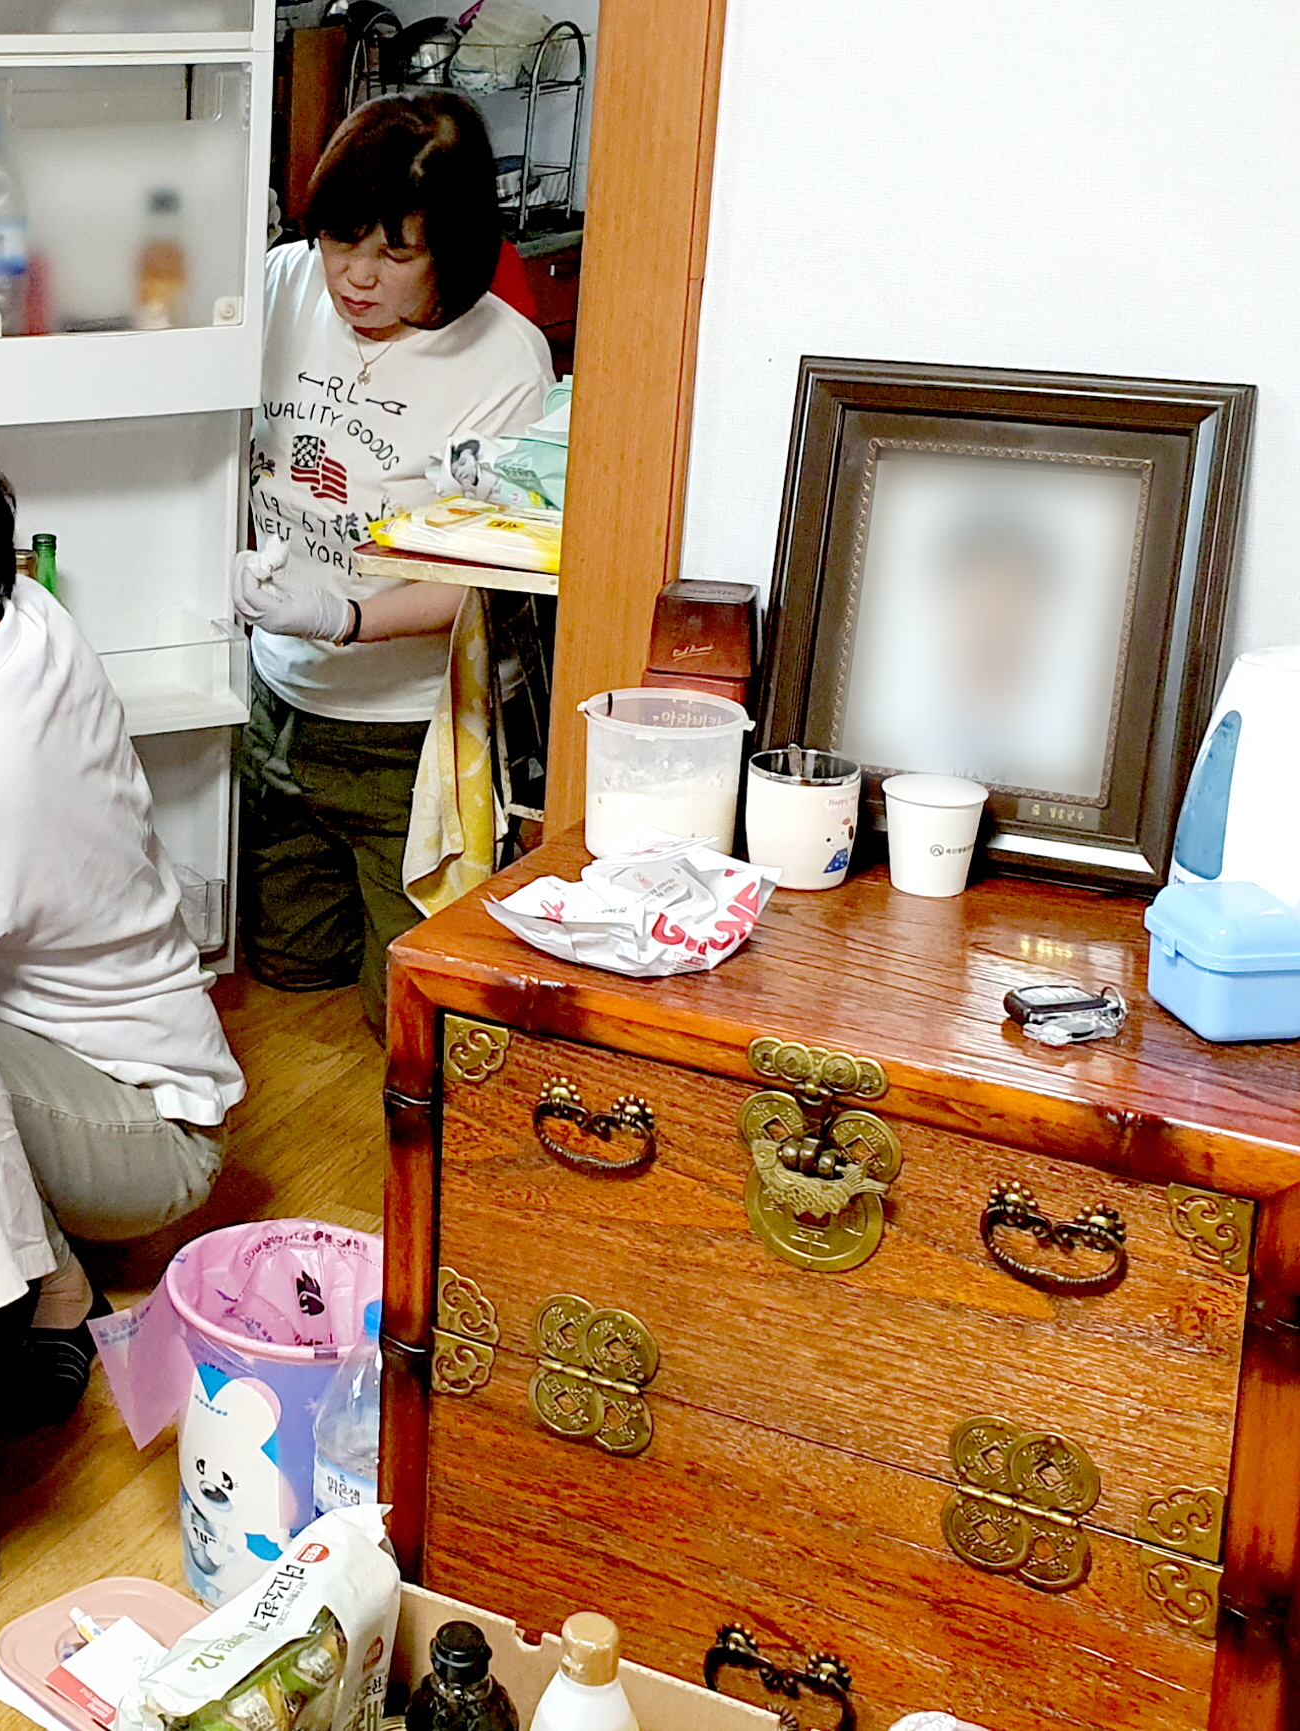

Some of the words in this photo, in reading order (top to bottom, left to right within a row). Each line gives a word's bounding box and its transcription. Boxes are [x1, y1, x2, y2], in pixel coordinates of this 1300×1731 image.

[326, 376, 360, 405] RL
[347, 419, 400, 471] GOODS
[260, 490, 282, 517] 19
[254, 513, 292, 542] NEW
[327, 1475, 360, 1505] 맑은샘
